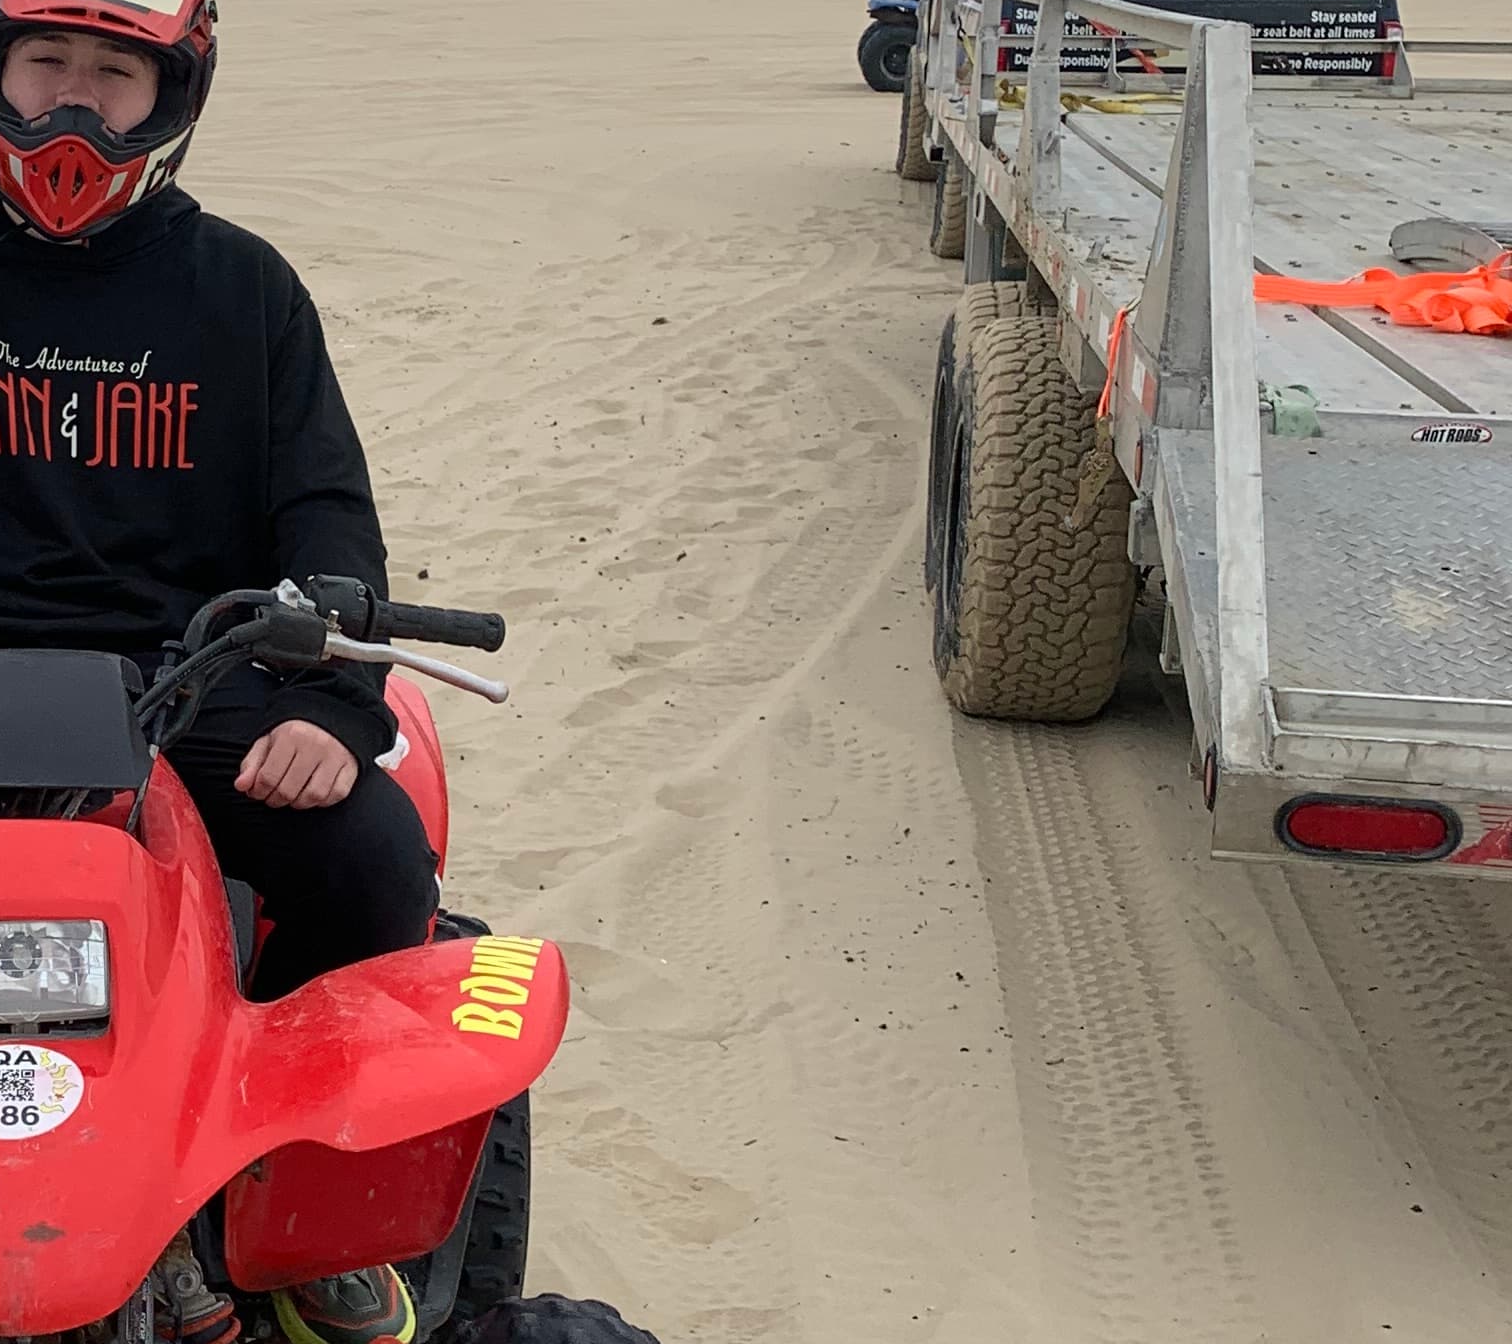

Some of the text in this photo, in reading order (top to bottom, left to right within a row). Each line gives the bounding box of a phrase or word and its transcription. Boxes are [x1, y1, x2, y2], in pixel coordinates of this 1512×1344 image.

[1311, 11, 1377, 25] Stay seated
[1072, 24, 1093, 35] belt
[1263, 26, 1287, 38] seat
[1289, 25, 1311, 38] belt
[1313, 26, 1325, 38] at
[1328, 26, 1342, 38] all
[1343, 26, 1376, 38] times
[1060, 53, 1110, 69] sponsibly
[1304, 57, 1372, 72] Responsibly
[25, 347, 124, 374] Adventures
[130, 350, 153, 379] of
[85, 381, 199, 469] JAKE
[1420, 428, 1482, 443] HOT RODS
